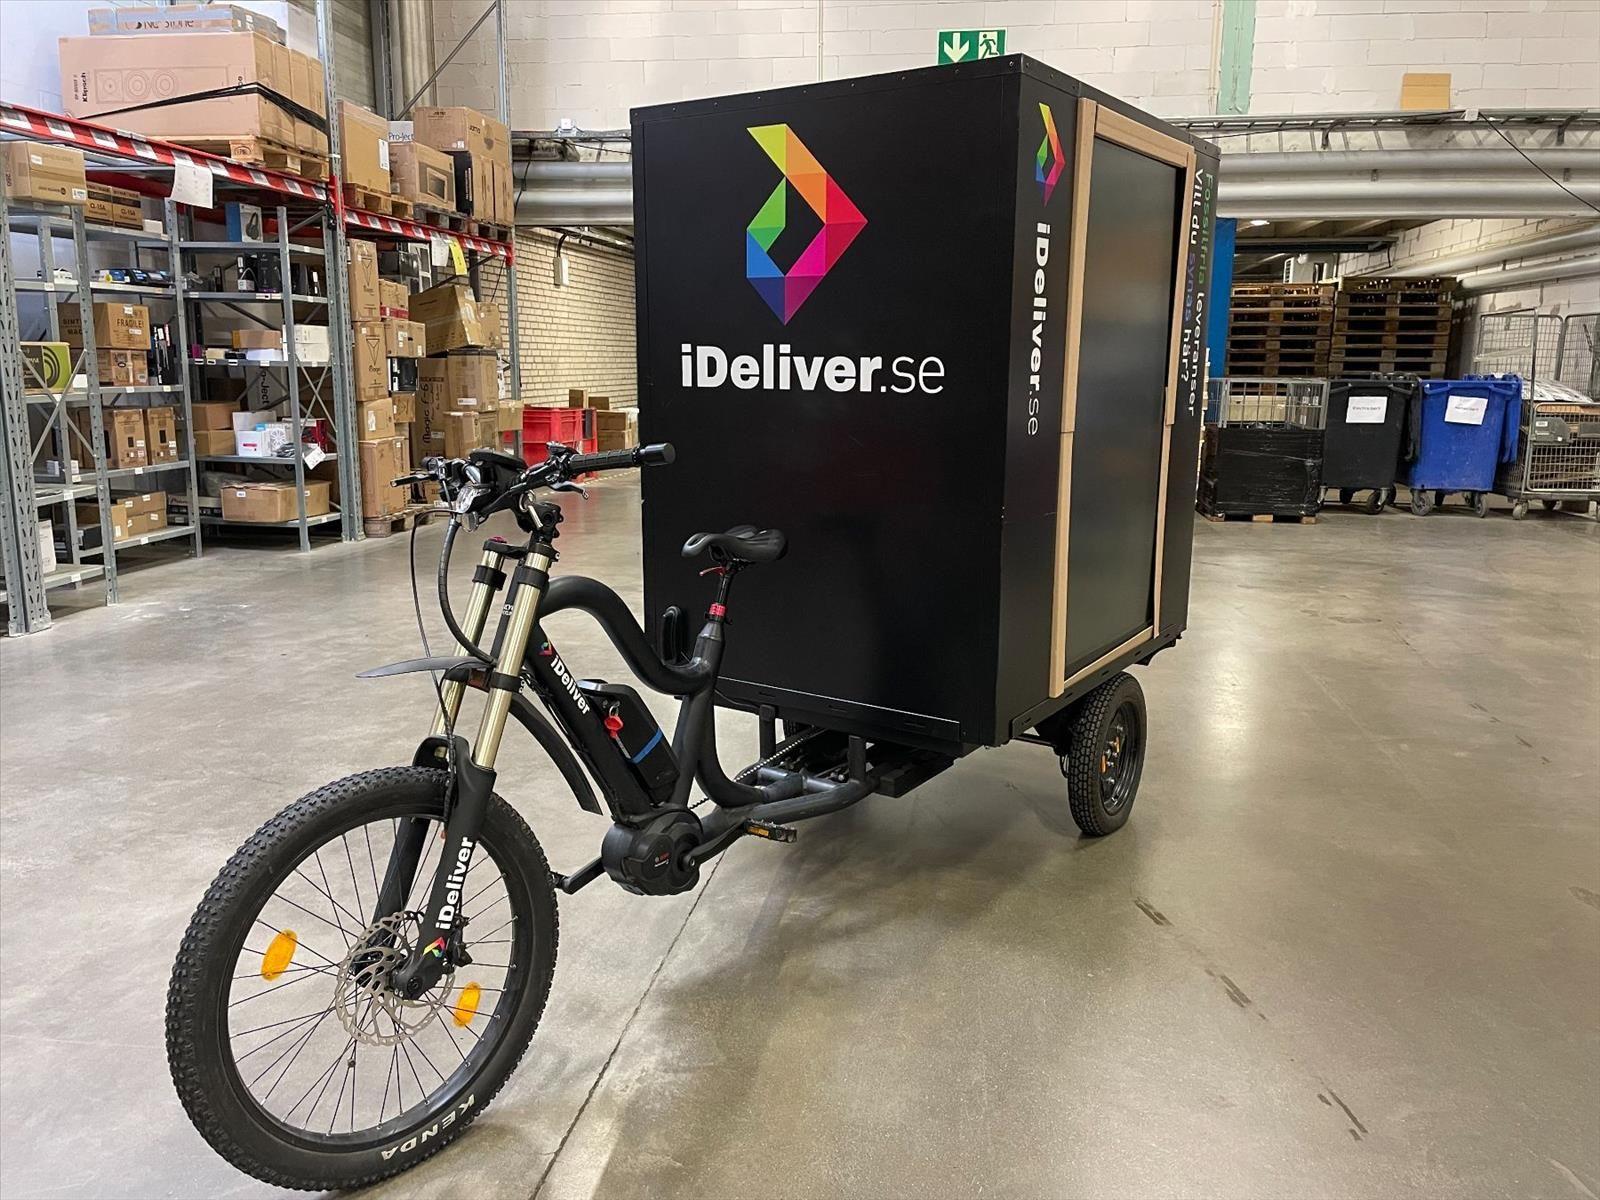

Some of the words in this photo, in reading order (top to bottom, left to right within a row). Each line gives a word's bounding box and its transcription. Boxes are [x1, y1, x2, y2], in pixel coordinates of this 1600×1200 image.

[1193, 168, 1204, 208] Vill
[1190, 214, 1201, 245] du
[1184, 252, 1196, 322] synas
[1027, 222, 1051, 435] iDeliver.se
[1181, 329, 1192, 382] här?
[1188, 292, 1205, 417] leveranser
[260, 366, 270, 405] o-Ject
[681, 343, 945, 394] iDeliver.se
[550, 654, 590, 715] iDeliver
[436, 836, 477, 930] iDeliver
[381, 1093, 475, 1161] KENDA
